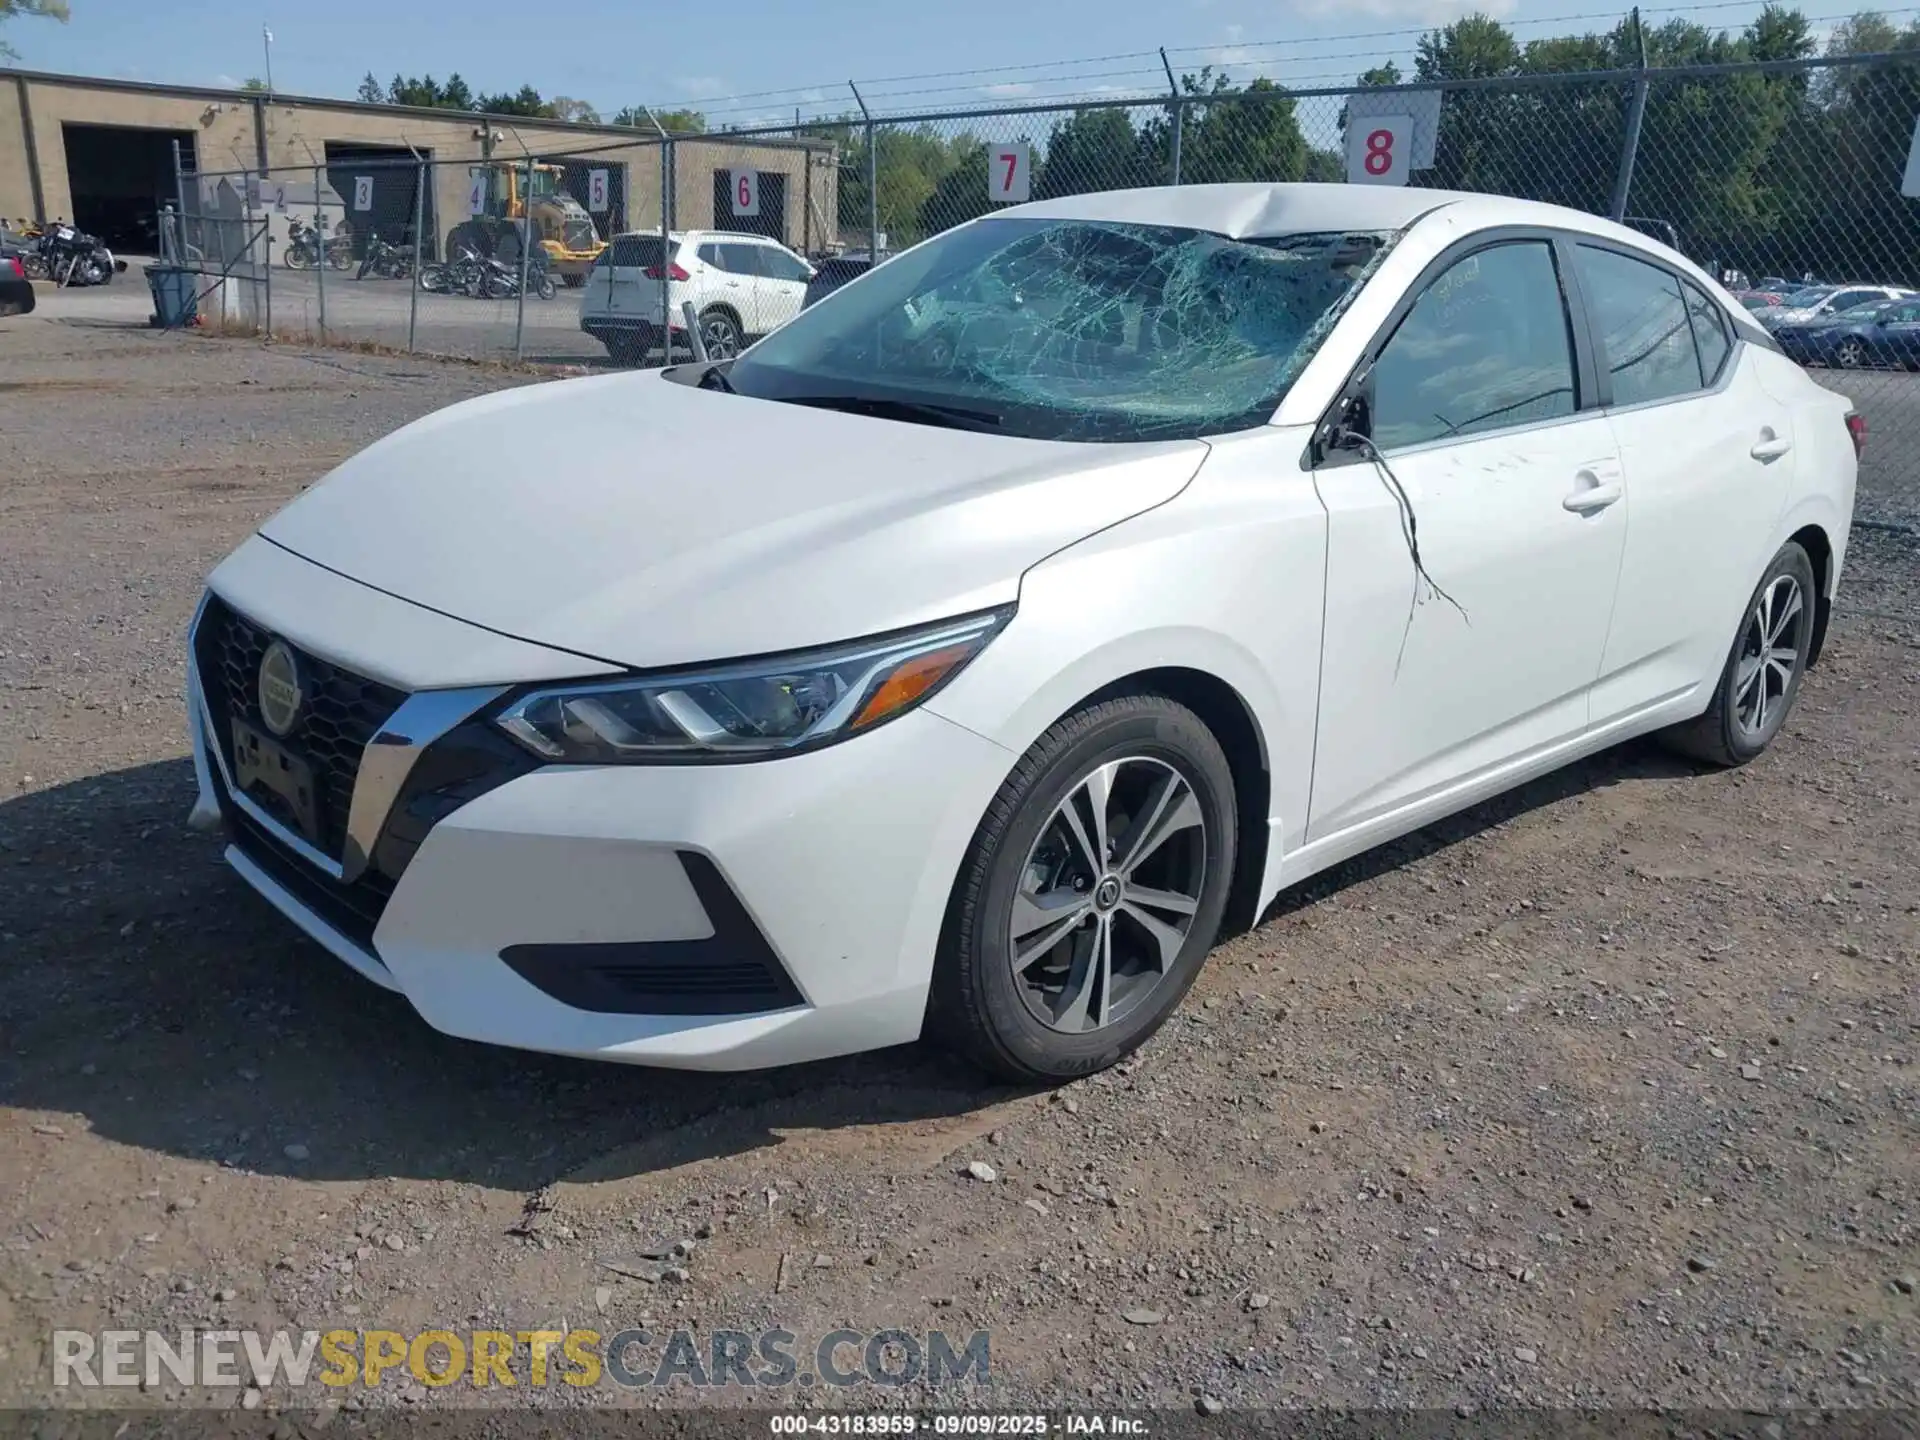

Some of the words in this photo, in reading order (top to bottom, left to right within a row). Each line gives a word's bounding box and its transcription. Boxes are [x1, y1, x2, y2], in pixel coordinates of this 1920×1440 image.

[1364, 129, 1394, 175] 8
[999, 153, 1017, 192] 7
[276, 186, 285, 208] 2
[358, 182, 368, 205] 3
[470, 184, 480, 208] 4
[593, 177, 603, 203] 5
[738, 175, 751, 208] 6
